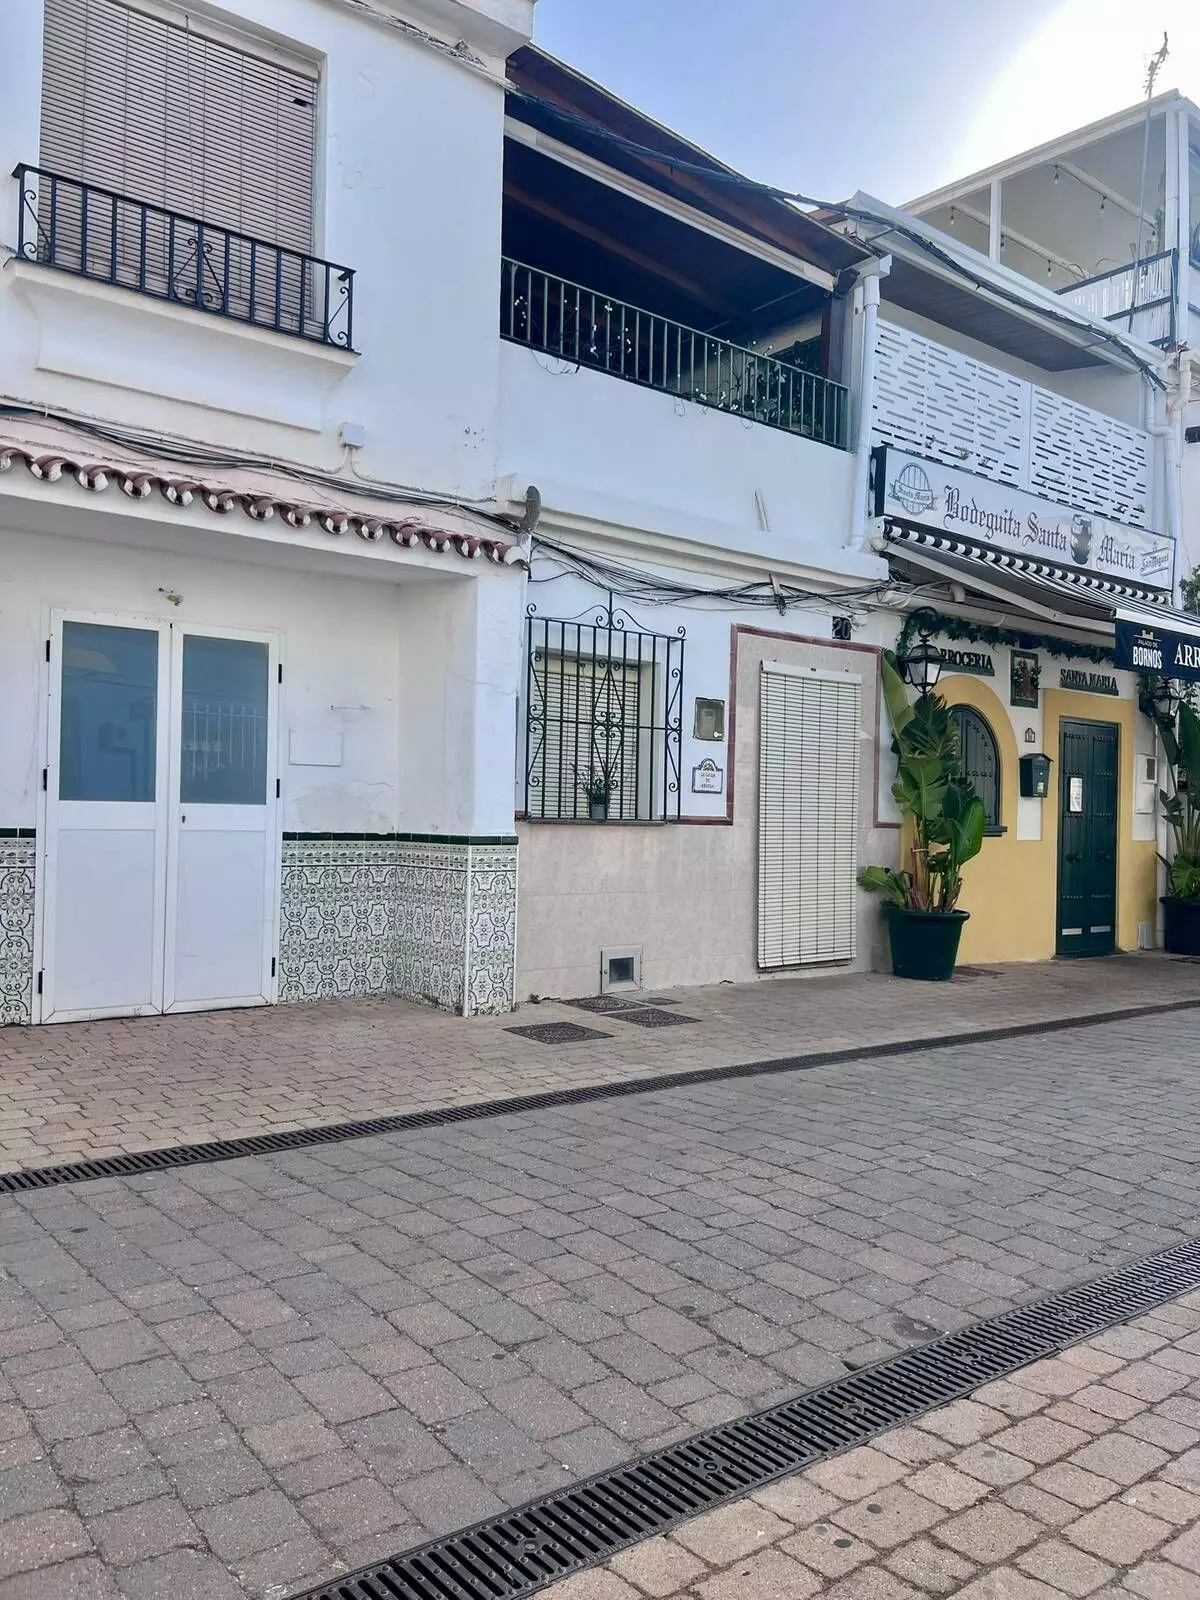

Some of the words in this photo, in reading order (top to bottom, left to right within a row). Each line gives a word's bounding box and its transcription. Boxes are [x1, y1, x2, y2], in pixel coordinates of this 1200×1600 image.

[943, 485, 1021, 540] Bodeguita
[1021, 512, 1068, 551] Santa
[1096, 535, 1136, 571] María
[939, 648, 994, 670] RROCERIA
[1133, 646, 1162, 669] BORNOS
[1060, 668, 1088, 686] SANTA
